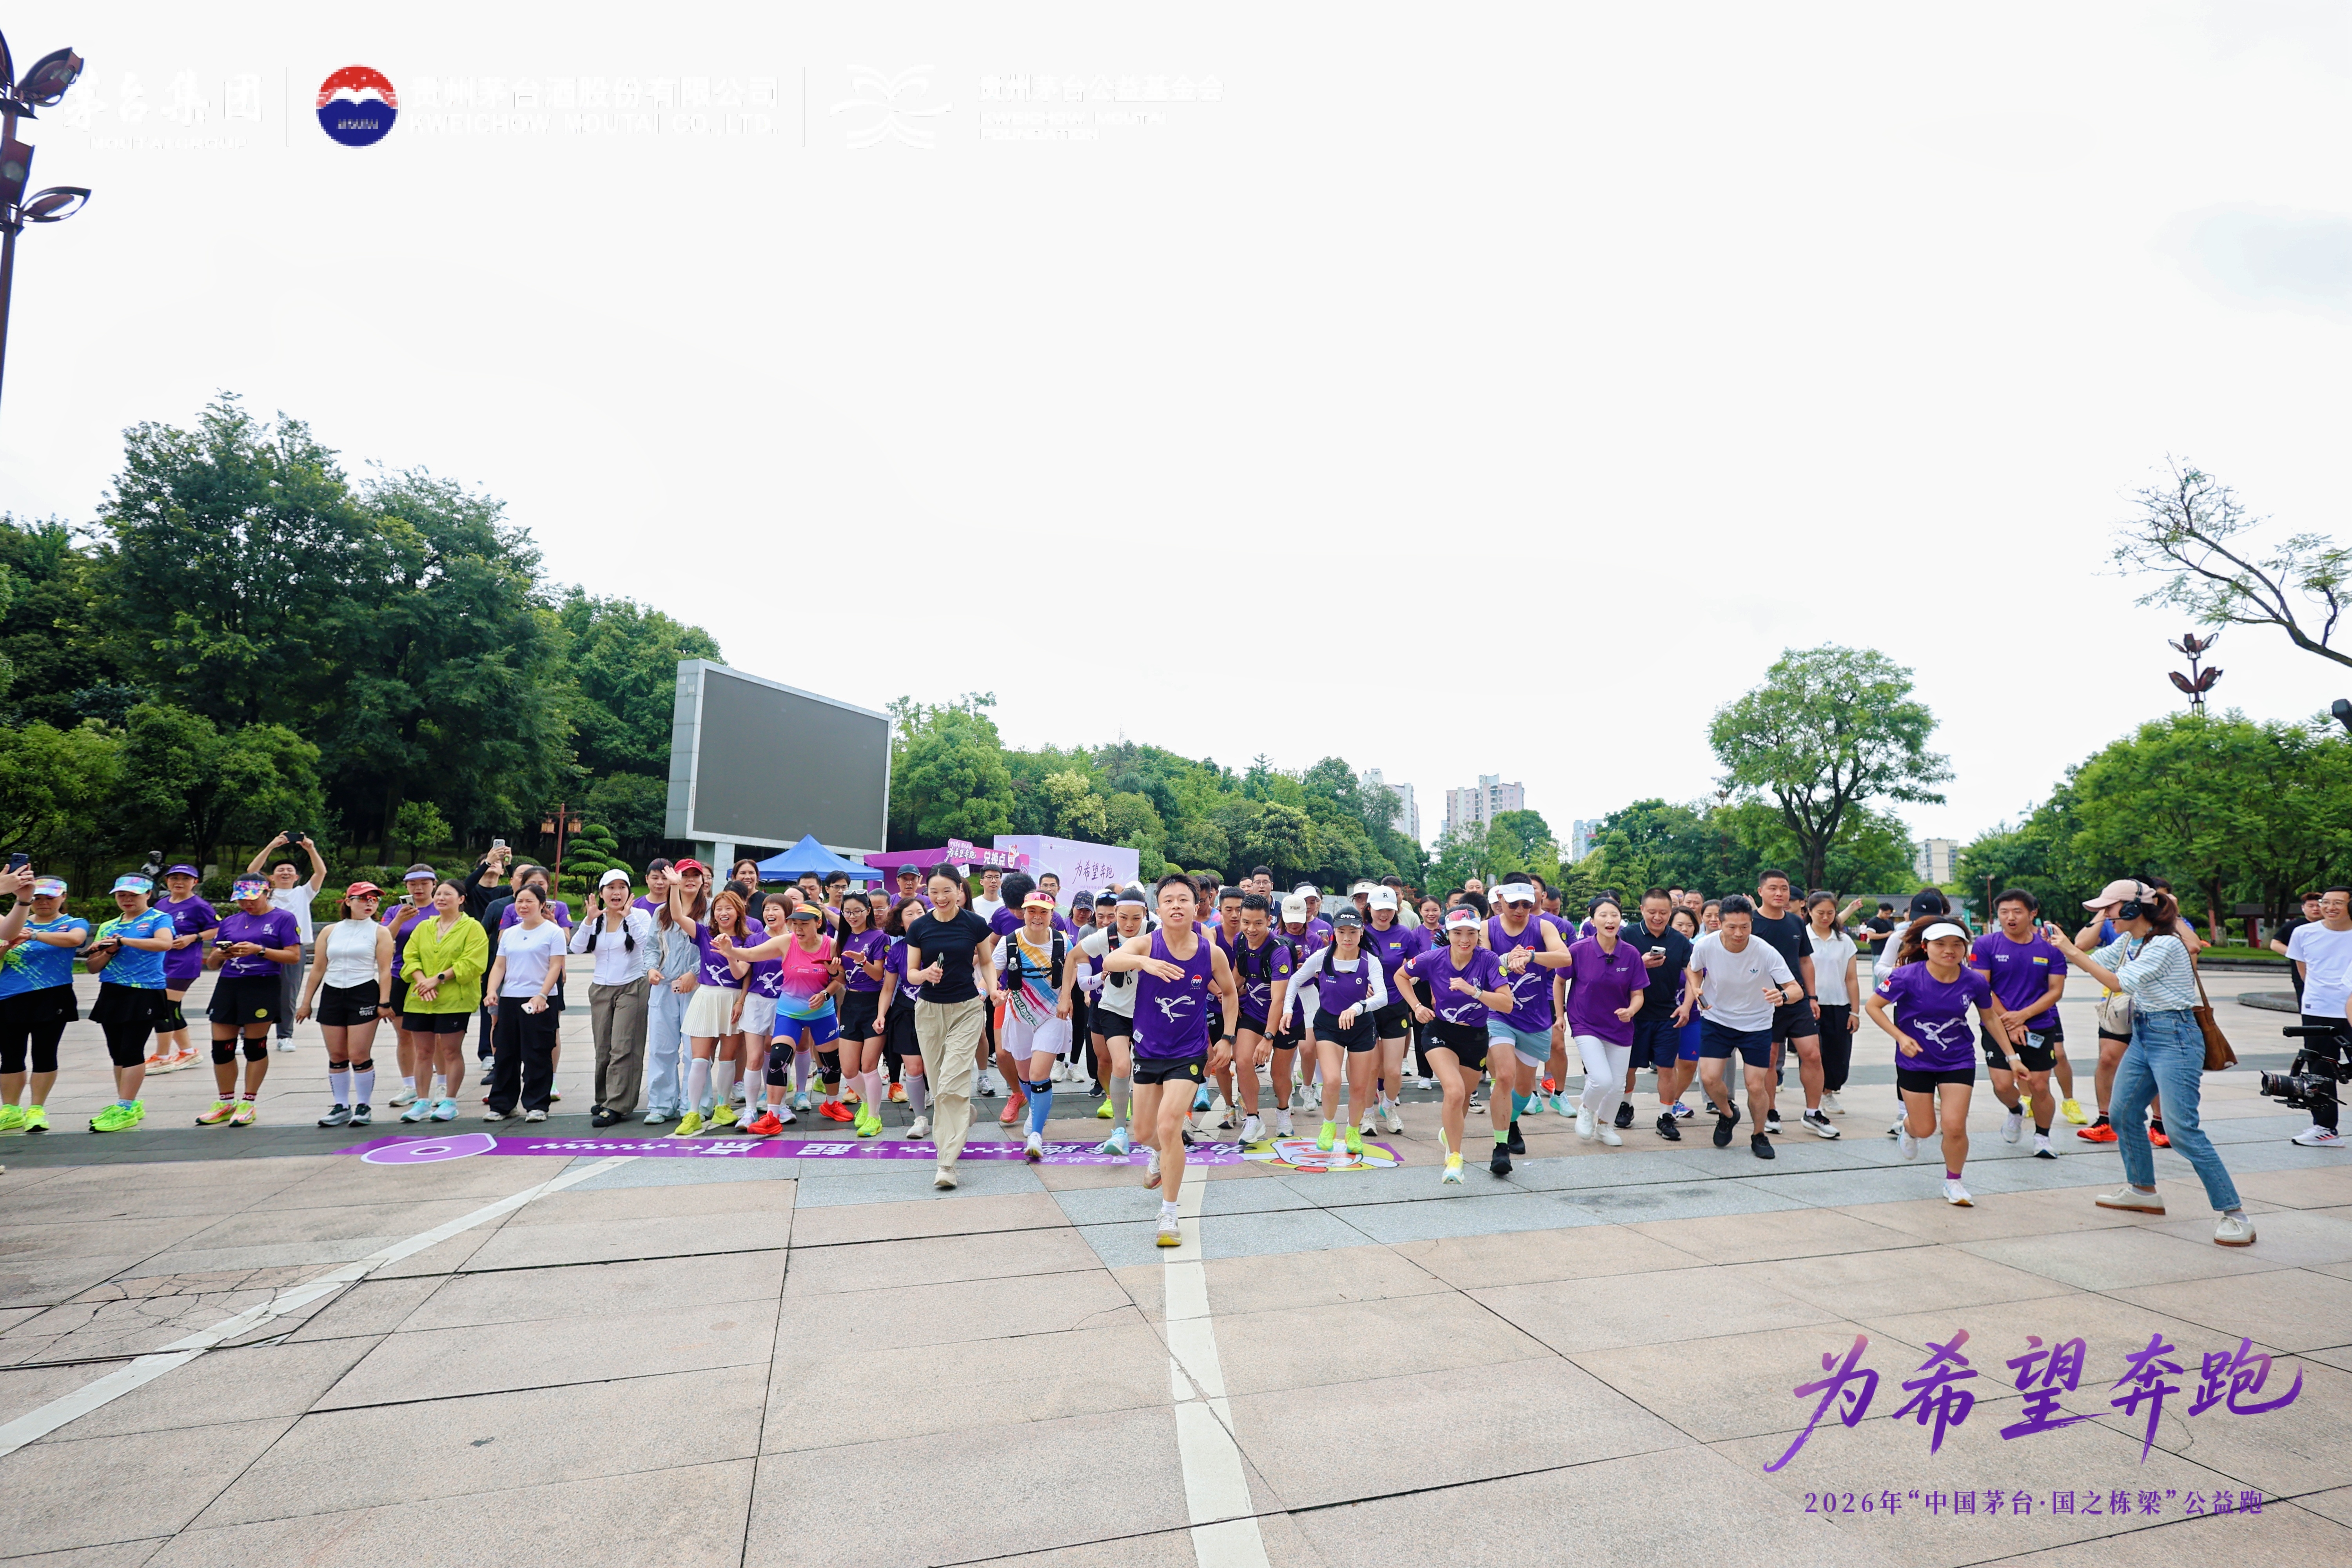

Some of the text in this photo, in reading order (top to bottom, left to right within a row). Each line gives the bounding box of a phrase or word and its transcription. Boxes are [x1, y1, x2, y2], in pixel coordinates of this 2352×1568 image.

[944, 846, 976, 862] 为希望奔跑
[984, 851, 1005, 866] 兑换点
[1072, 859, 1114, 885] 为希望奔跑
[1013, 991, 1033, 1021] EISUPAO
[699, 1142, 857, 1156] 起点
